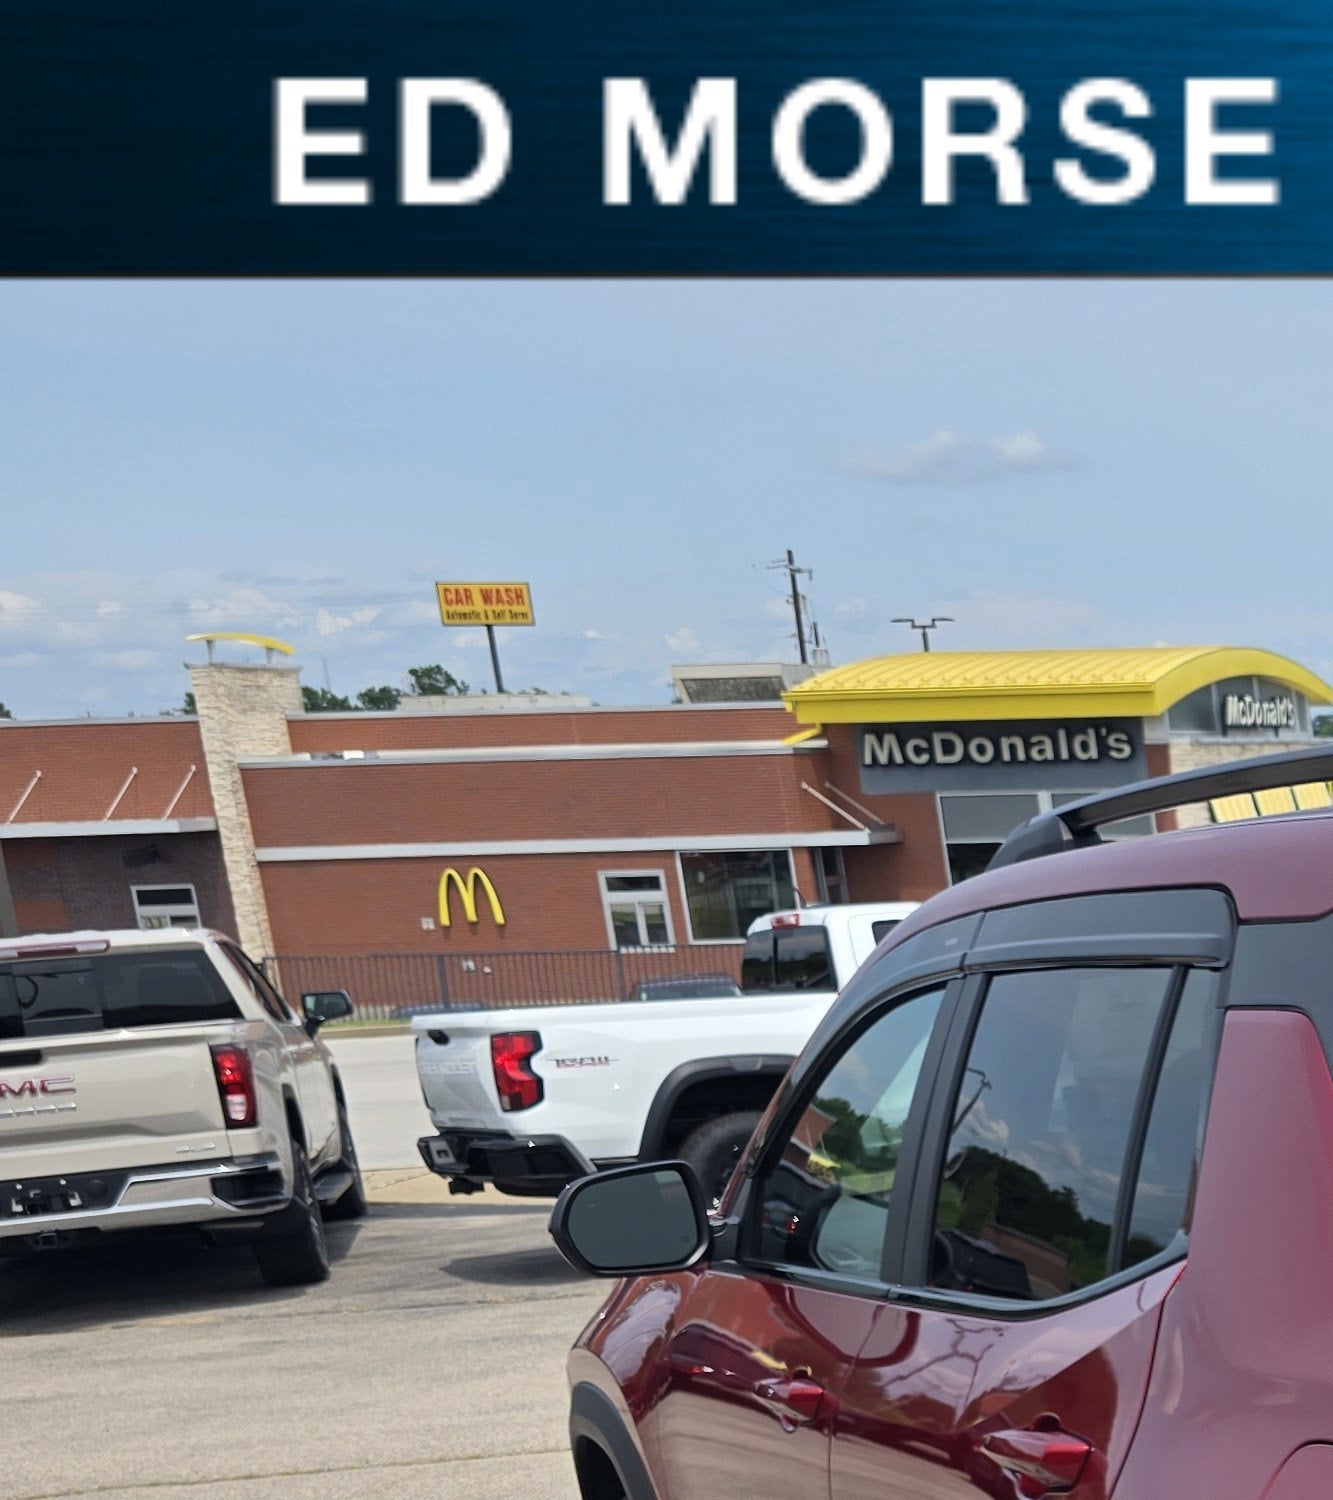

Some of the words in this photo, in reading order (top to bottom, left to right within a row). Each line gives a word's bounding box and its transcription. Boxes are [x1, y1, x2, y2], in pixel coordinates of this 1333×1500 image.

[443, 586, 474, 607] CAR
[480, 586, 526, 606] WASH
[1225, 693, 1297, 727] McDonald's
[863, 726, 1133, 766] McDonald's
[0, 1074, 77, 1099] MC
